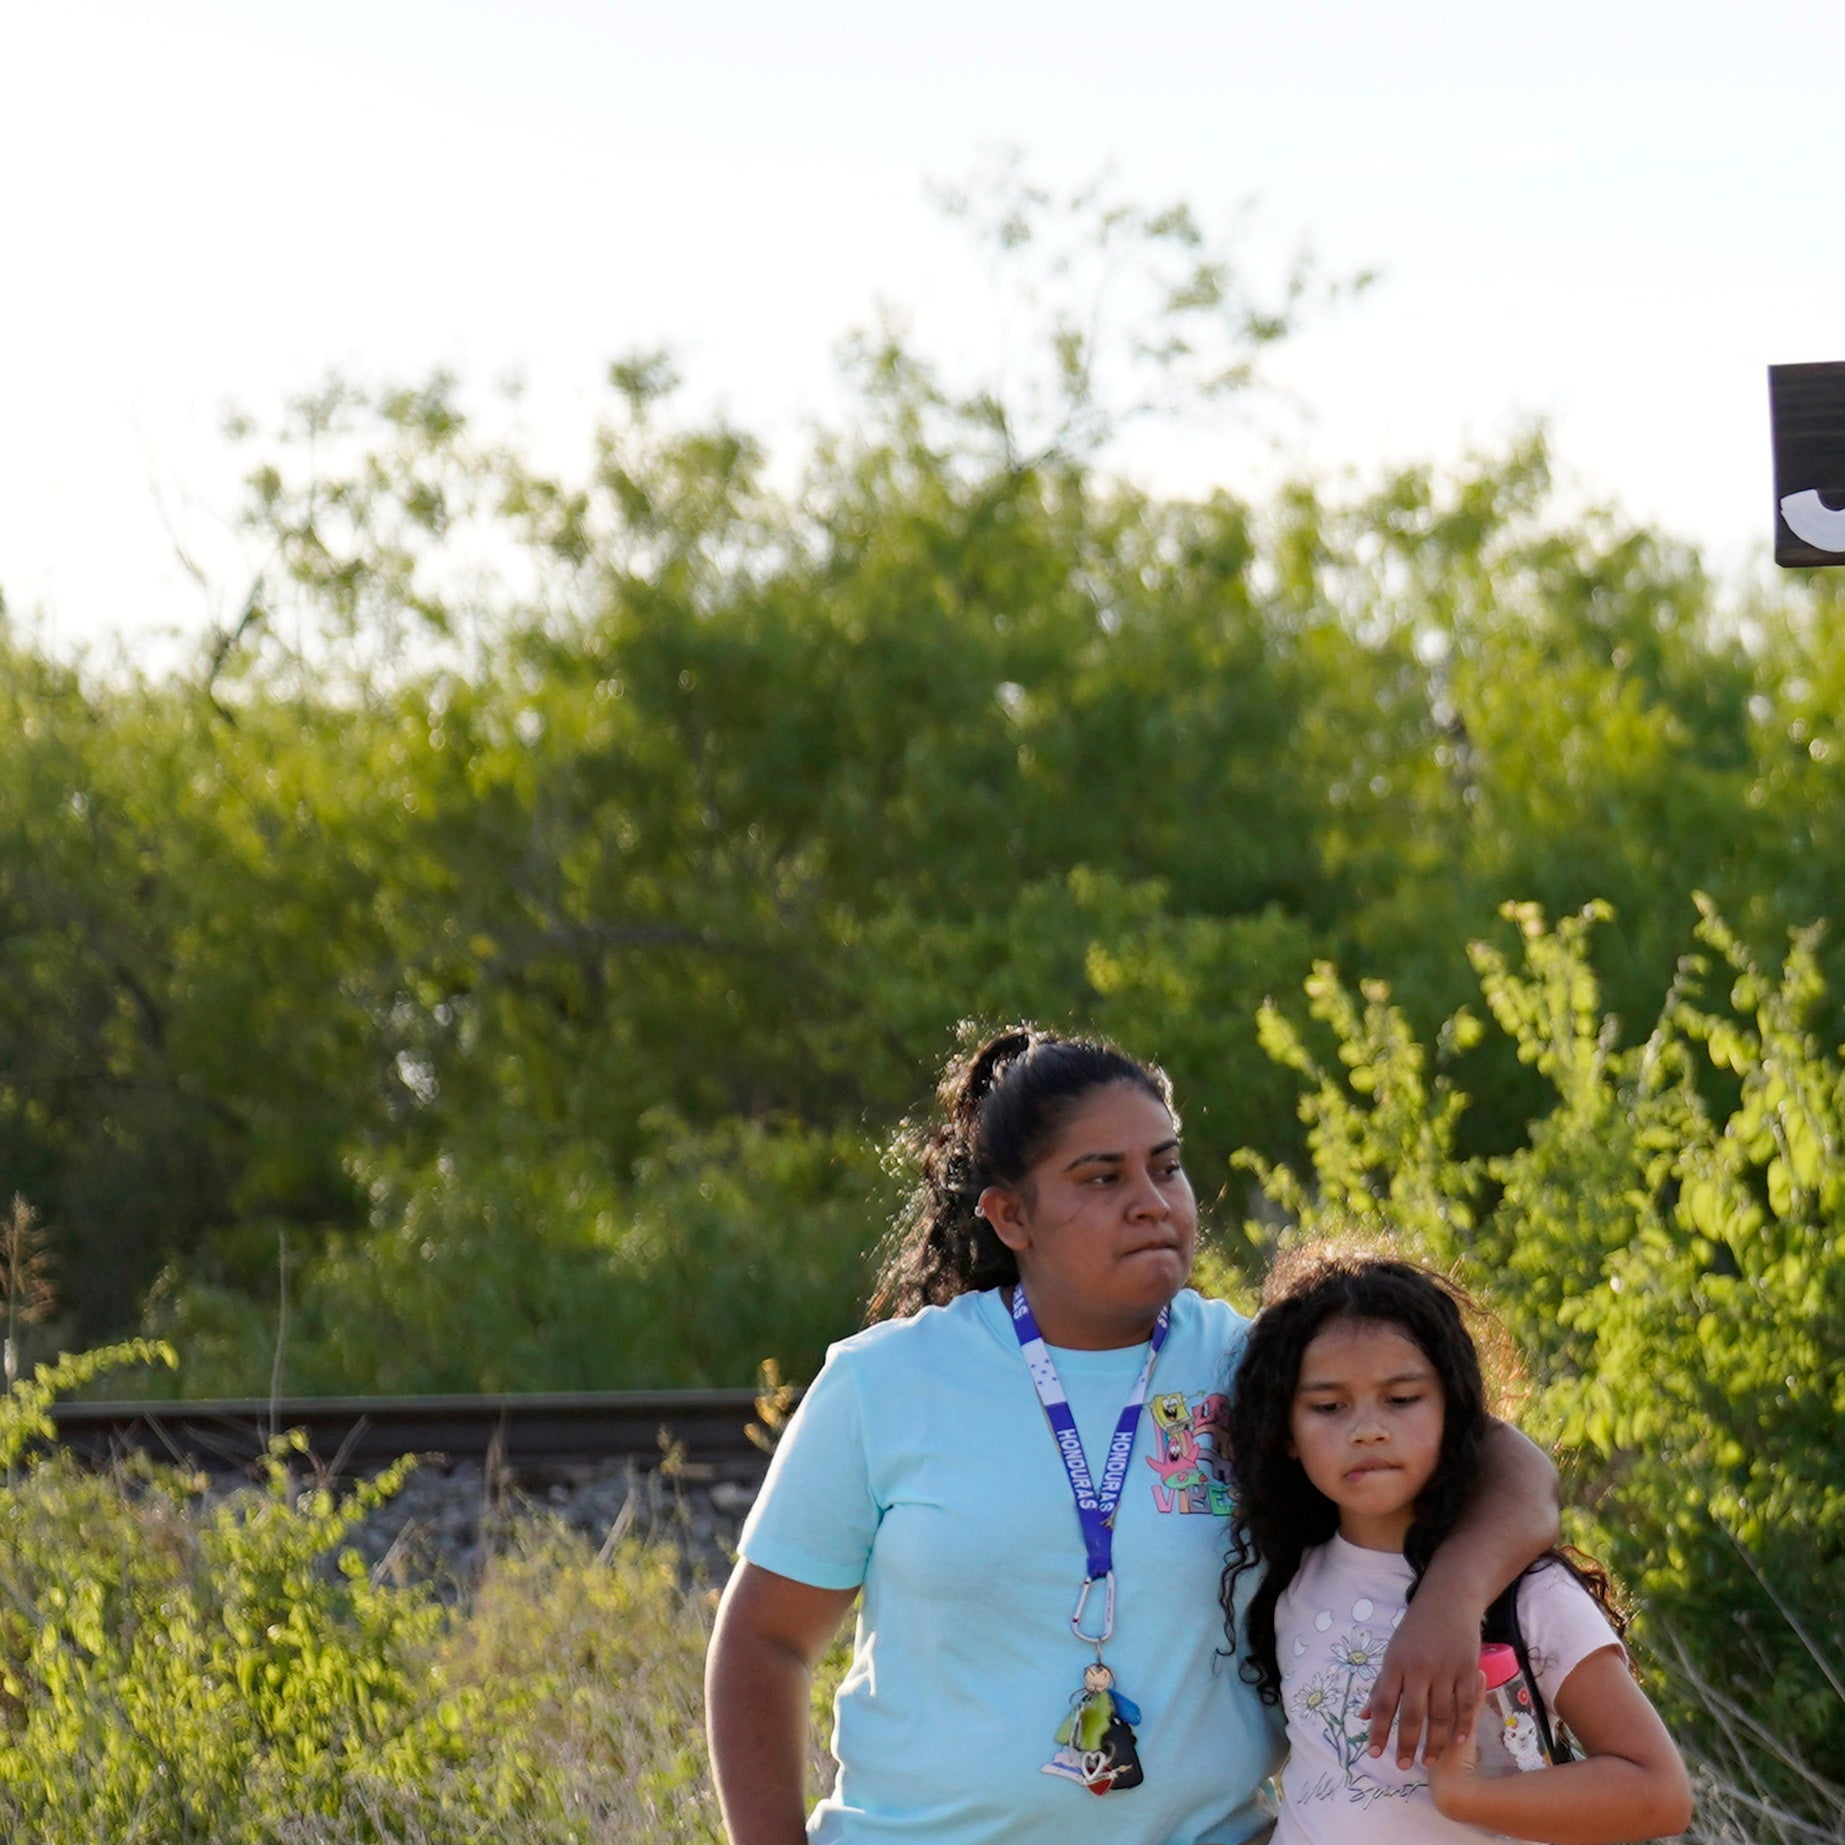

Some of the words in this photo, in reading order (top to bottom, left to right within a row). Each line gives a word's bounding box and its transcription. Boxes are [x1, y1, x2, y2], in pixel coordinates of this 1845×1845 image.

[1057, 1428, 1098, 1511] HONDURAS
[1100, 1431, 1133, 1513] HONDURAS
[1151, 1484, 1236, 1517] VIBE
